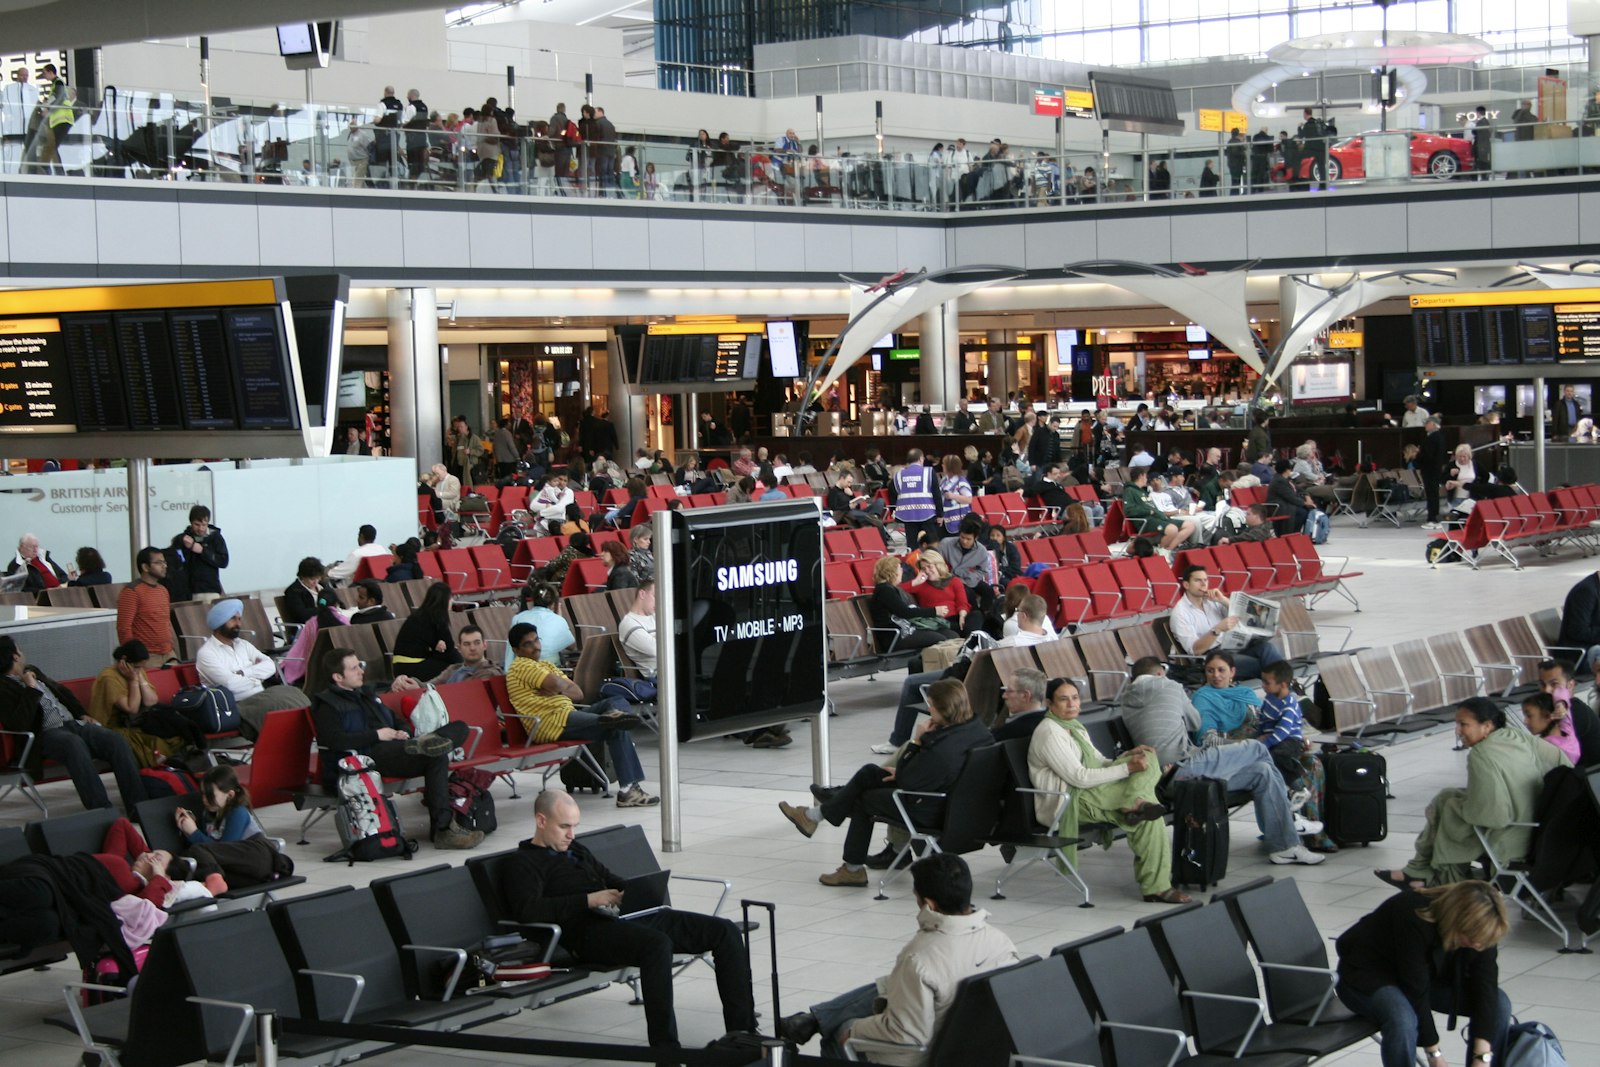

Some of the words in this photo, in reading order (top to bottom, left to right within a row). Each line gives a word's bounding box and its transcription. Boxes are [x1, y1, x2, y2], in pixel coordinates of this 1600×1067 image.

[1455, 111, 1500, 122] SOY
[1091, 375, 1119, 397] PRET
[51, 487, 100, 499] BRITISH
[51, 503, 103, 514] Customer
[717, 559, 798, 591] SAMSUNG
[714, 625, 728, 643] TV
[737, 618, 775, 639] MOBILE
[783, 614, 804, 633] MP3
